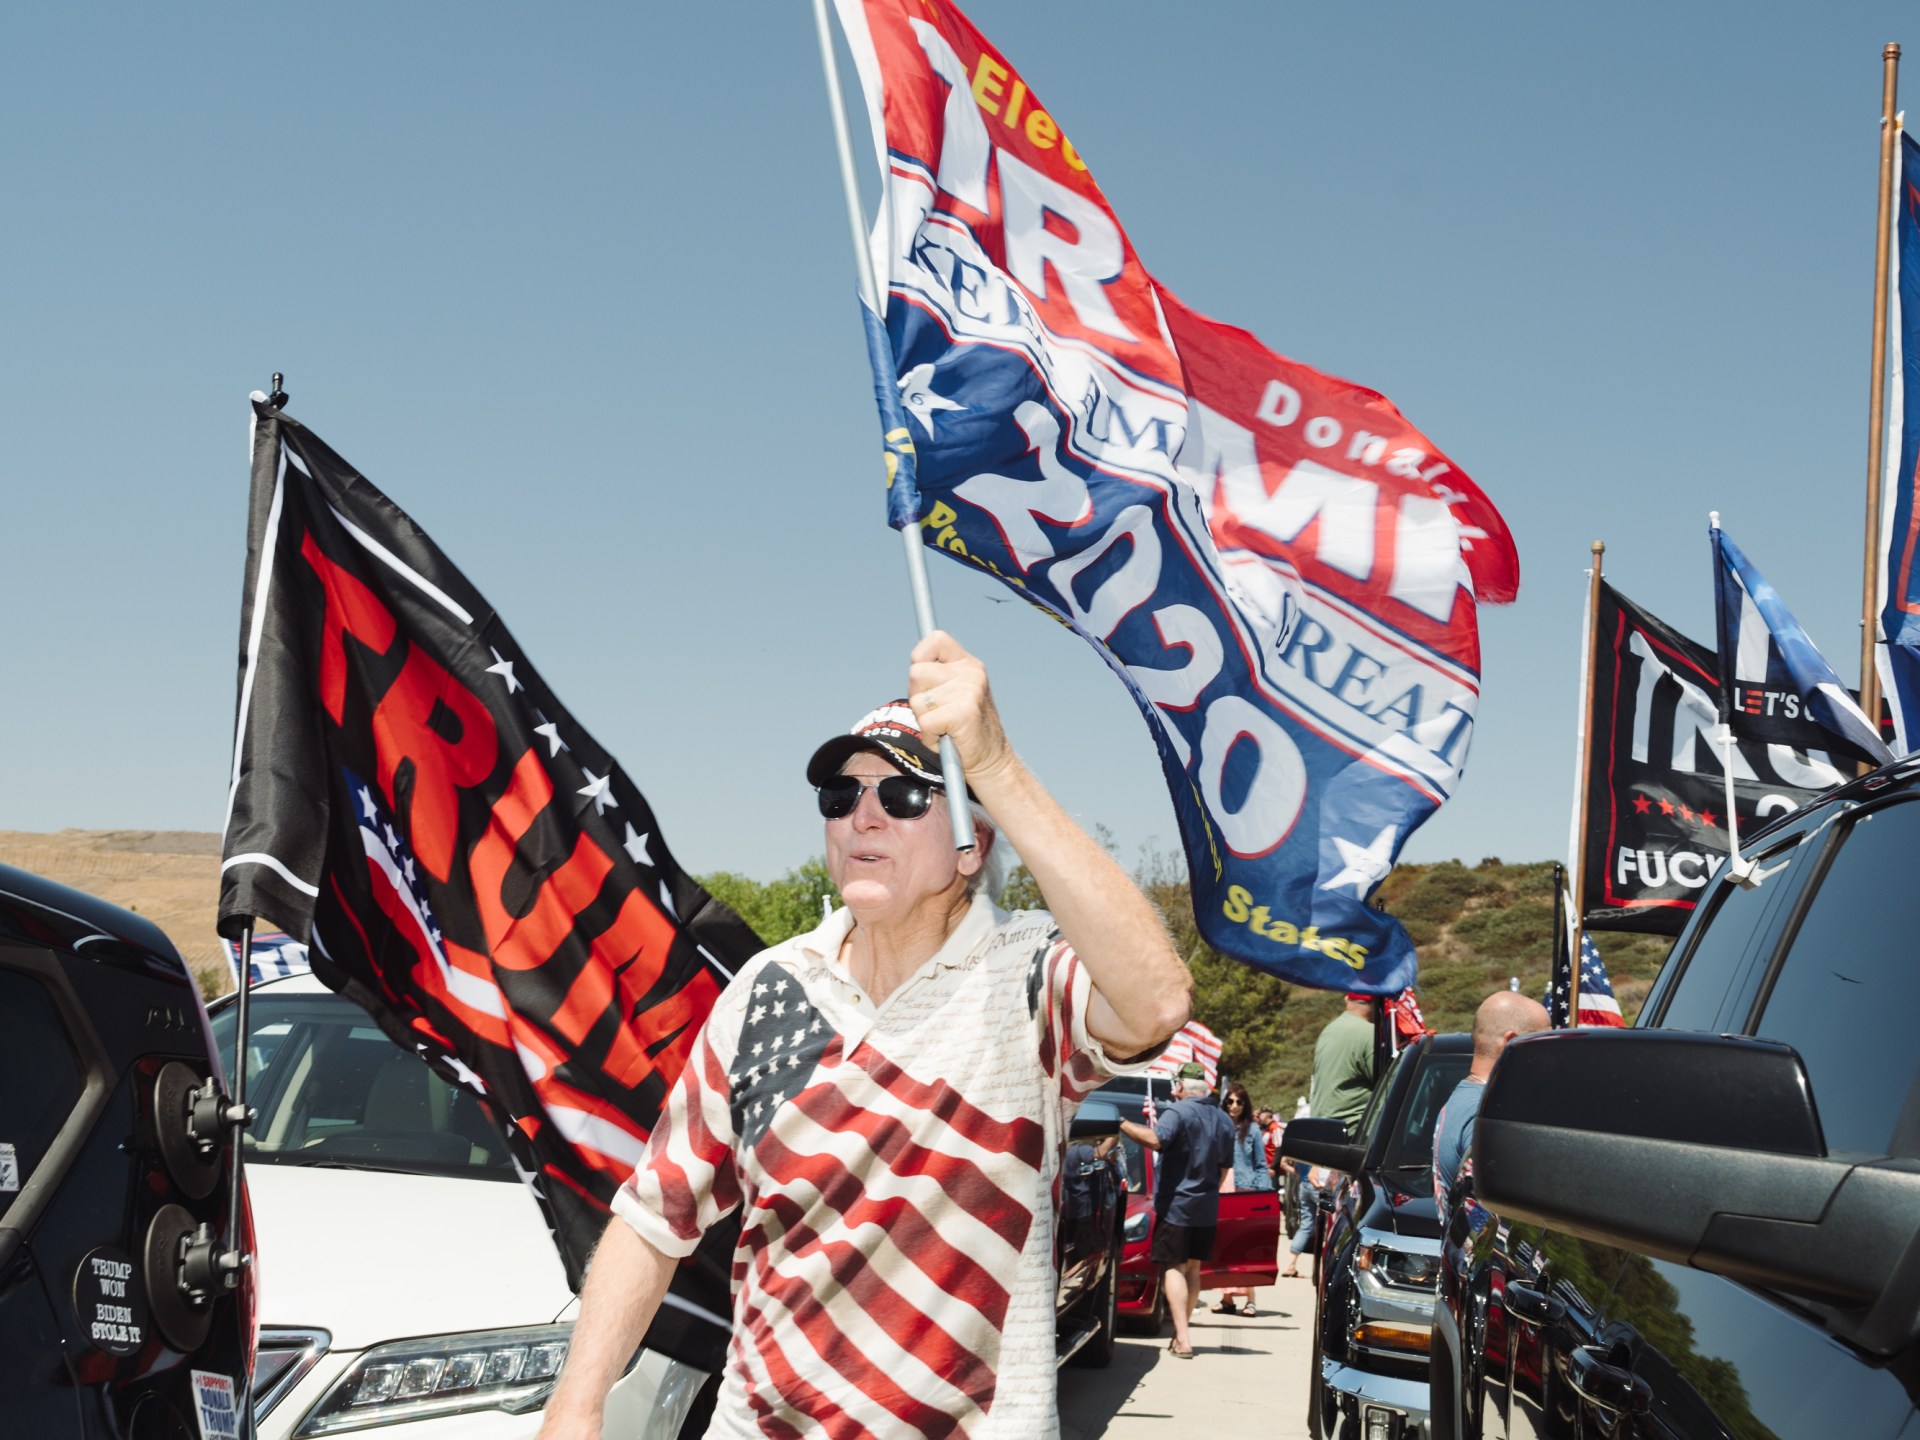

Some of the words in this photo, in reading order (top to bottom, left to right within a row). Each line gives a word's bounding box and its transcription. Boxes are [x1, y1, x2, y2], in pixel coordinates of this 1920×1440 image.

[952, 399, 1306, 860] 2020
[1276, 591, 1475, 768] REAT
[1734, 687, 1800, 718] LET'S
[863, 726, 902, 738] 2020
[300, 527, 722, 1112] TRUM
[1222, 884, 1370, 970] States
[91, 1257, 132, 1280] TRUMP
[99, 1278, 126, 1298] WON
[95, 1303, 132, 1324] BIDEN
[91, 1321, 129, 1342] STOLE
[128, 1326, 142, 1343] IT
[200, 1387, 232, 1410] DONALD
[200, 1406, 235, 1434] TRUMP
